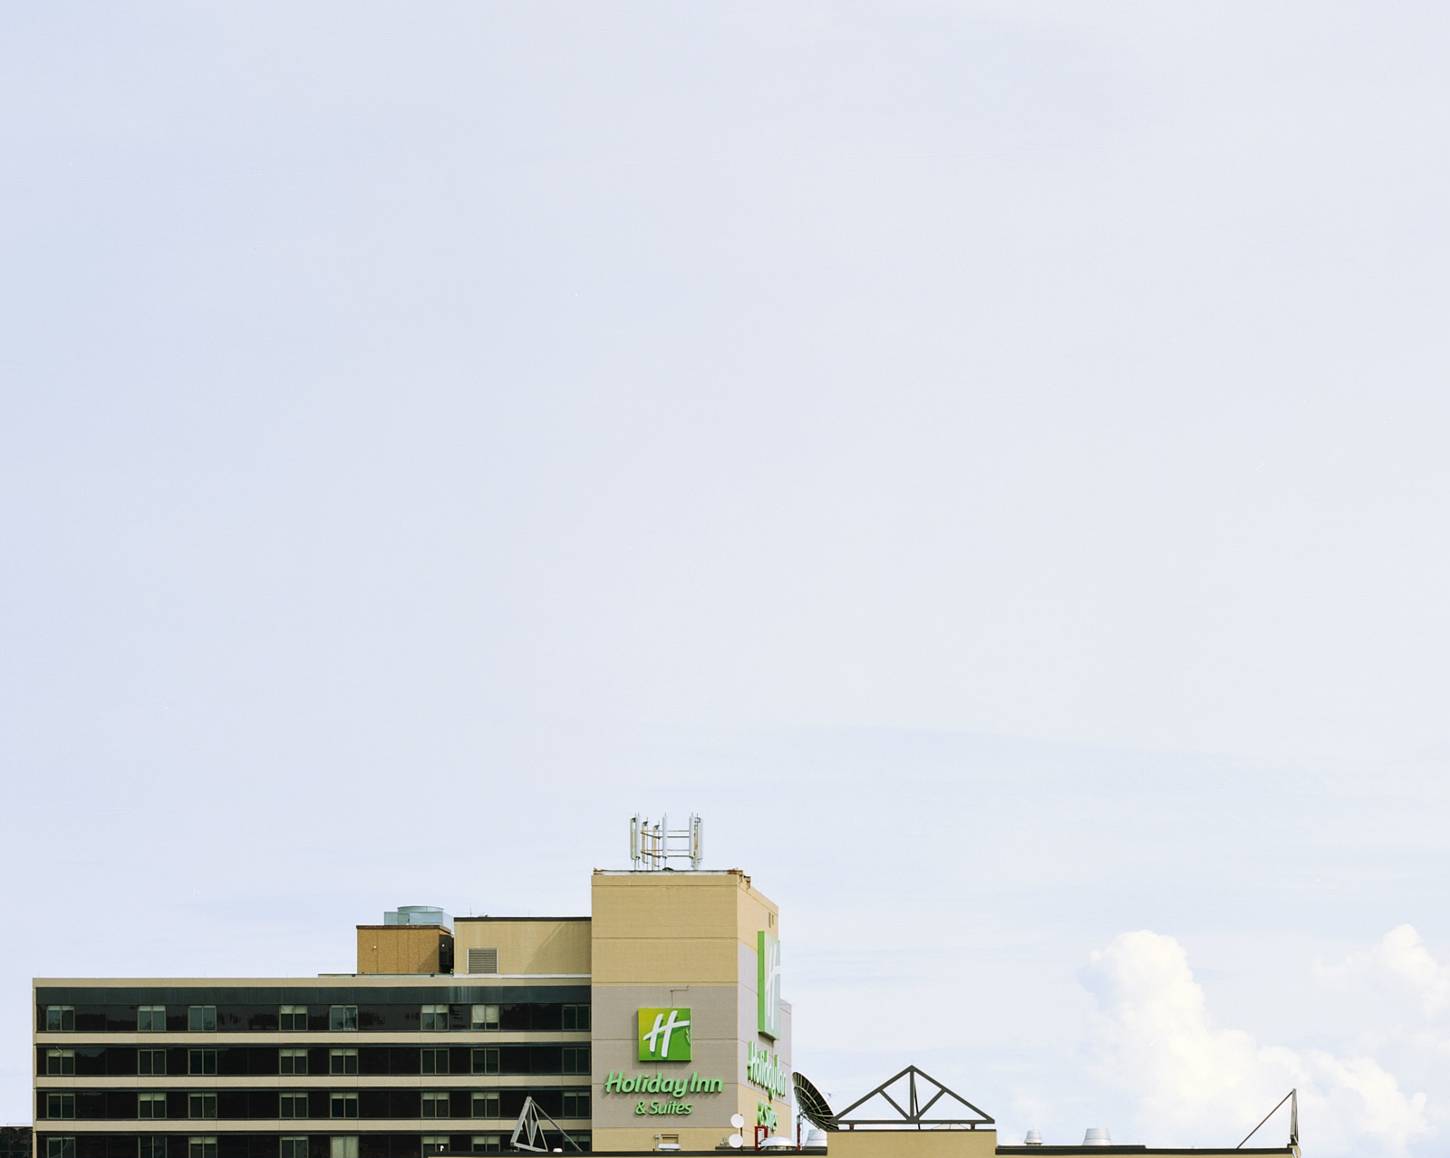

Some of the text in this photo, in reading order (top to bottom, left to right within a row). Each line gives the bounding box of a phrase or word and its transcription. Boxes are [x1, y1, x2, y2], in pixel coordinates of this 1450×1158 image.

[604, 1071, 724, 1098] Holiday Inn
[635, 1100, 695, 1116] & Suites
